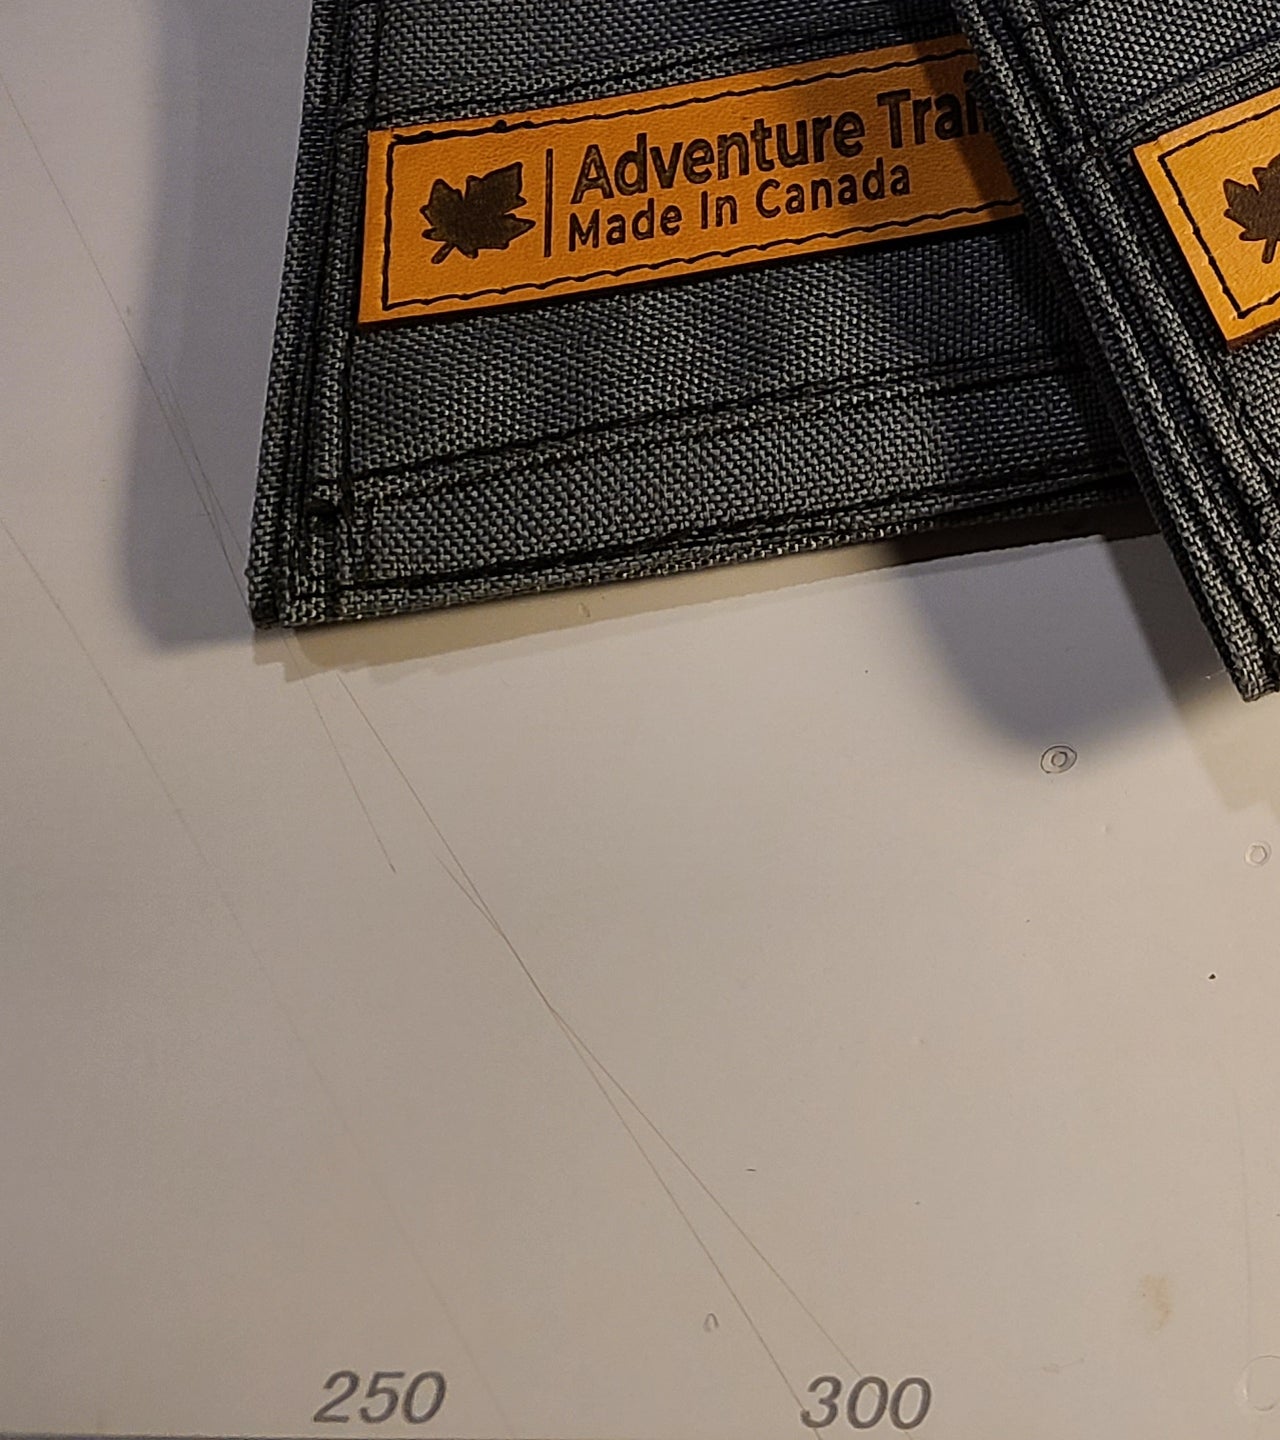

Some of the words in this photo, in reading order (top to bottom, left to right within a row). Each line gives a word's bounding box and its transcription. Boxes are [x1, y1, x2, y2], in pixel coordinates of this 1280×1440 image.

[570, 110, 866, 205] Adventure
[568, 198, 683, 252] Made
[700, 190, 738, 230] In
[755, 157, 911, 219] Canada
[312, 1370, 447, 1425] 250
[800, 1375, 932, 1430] 300
